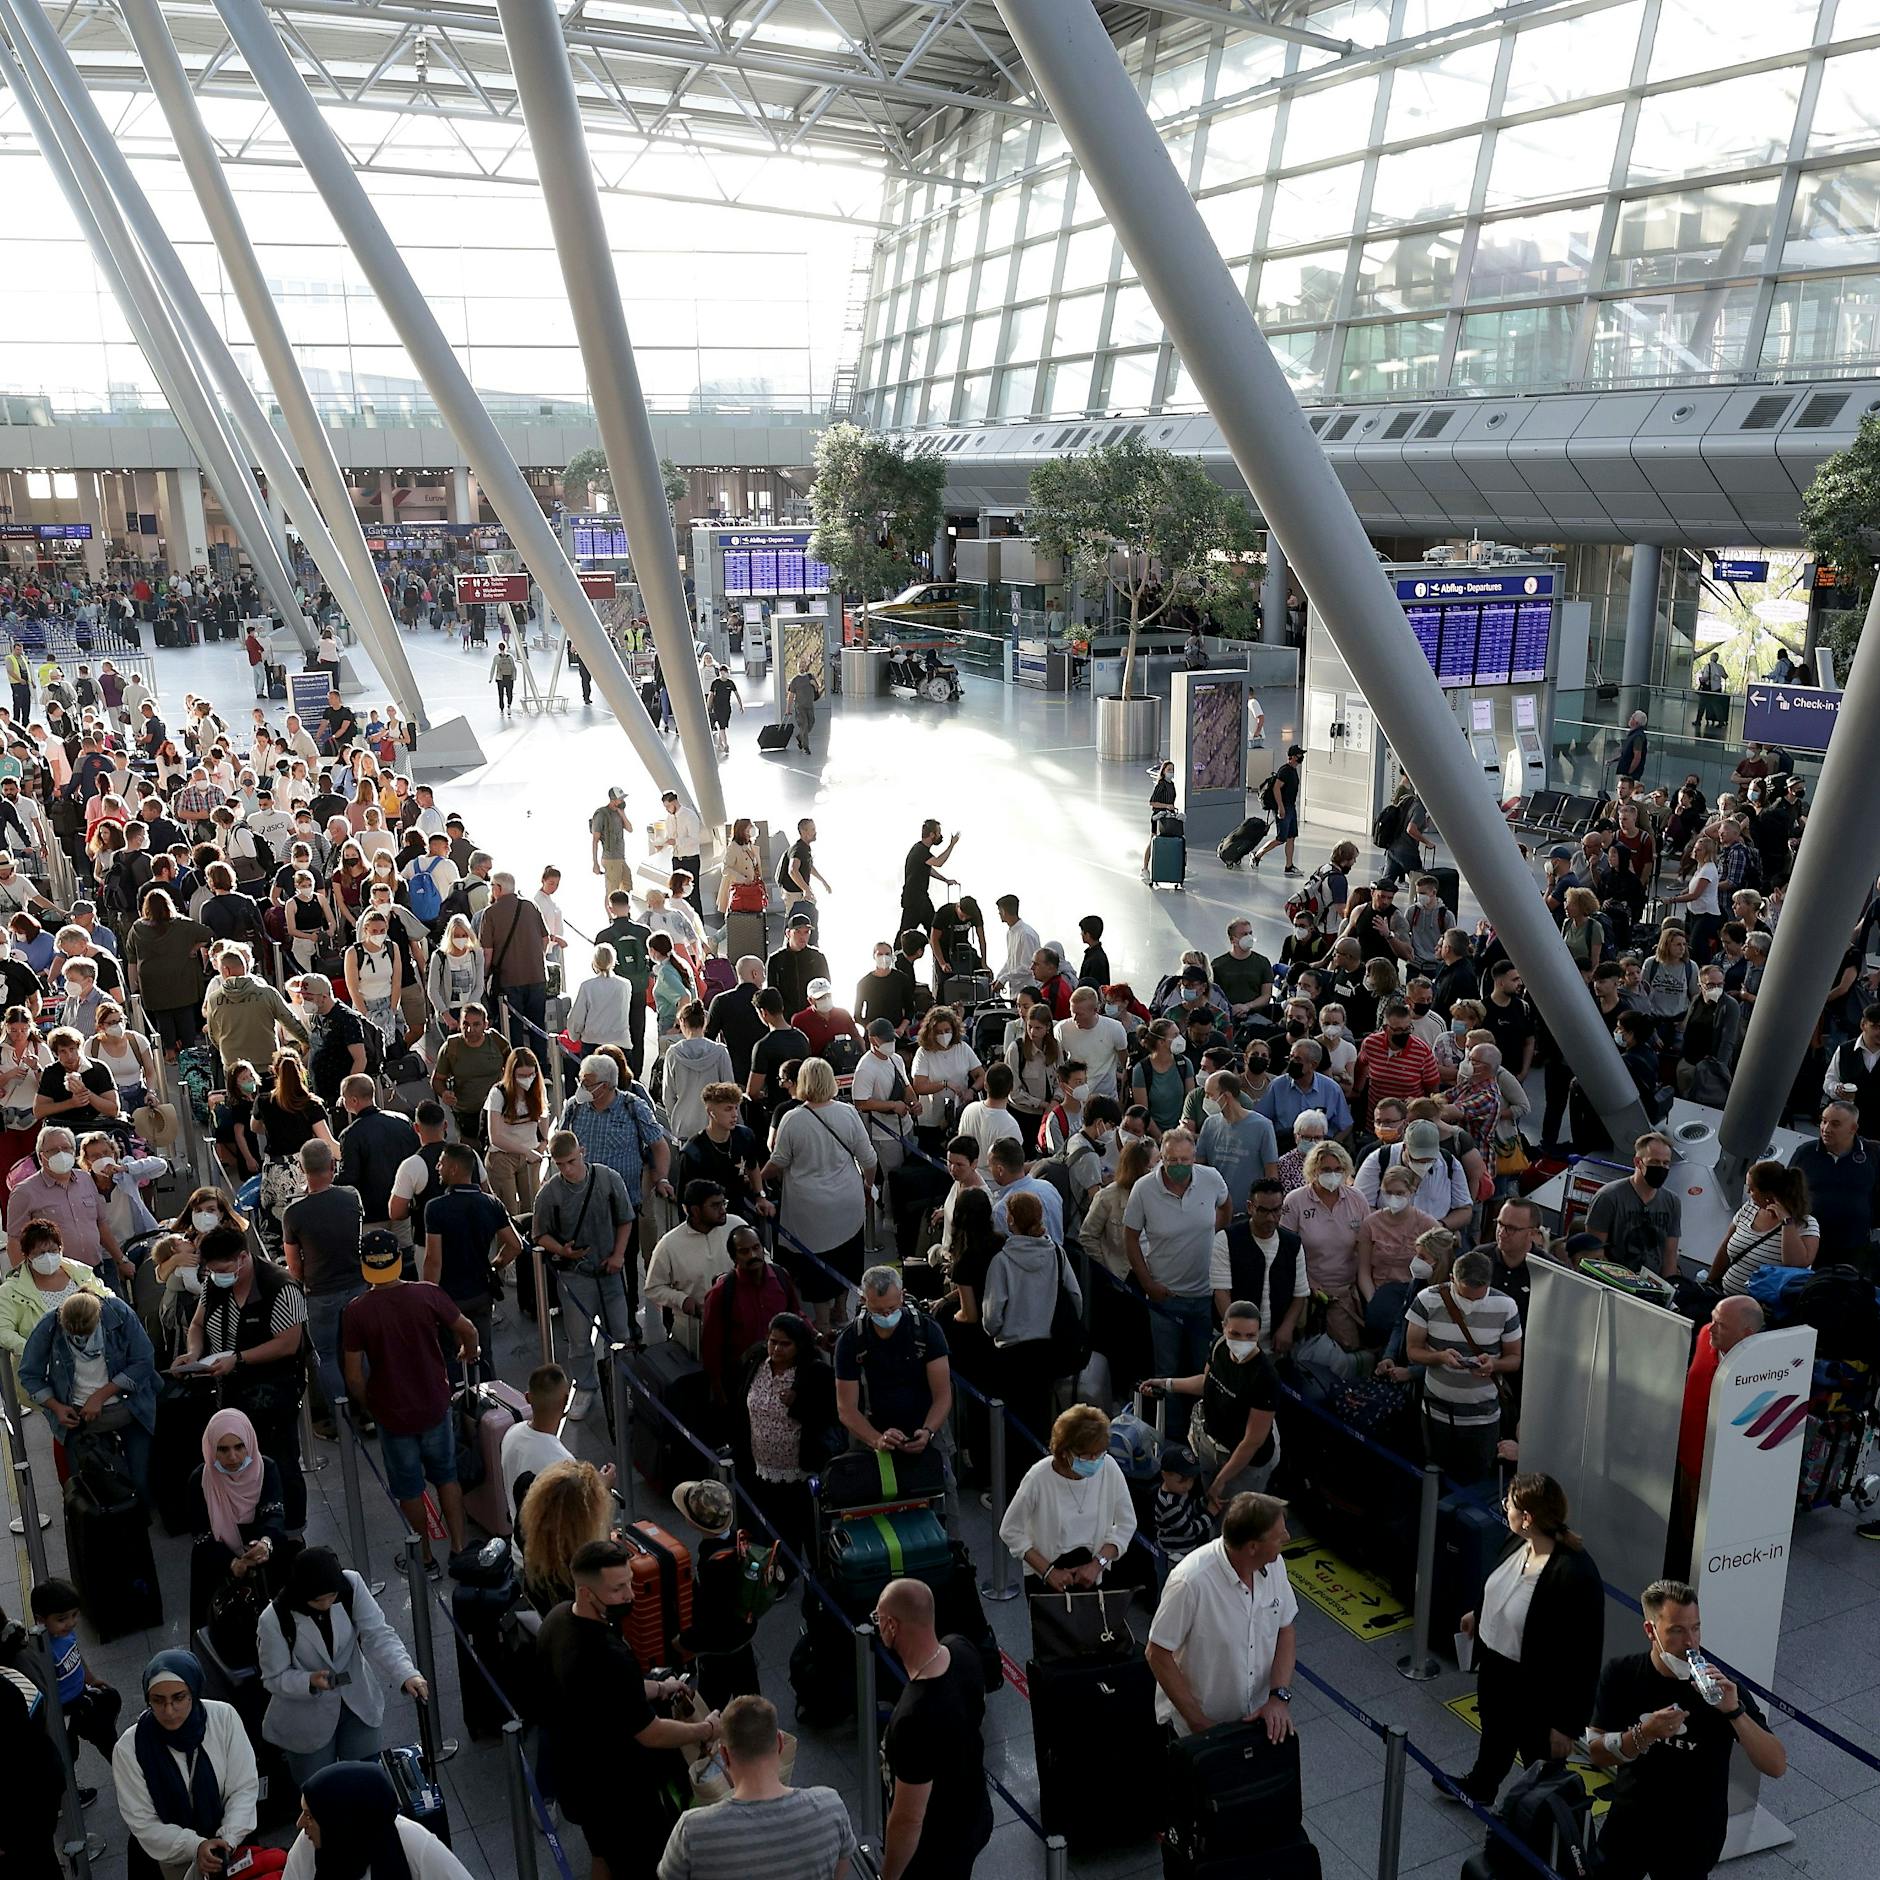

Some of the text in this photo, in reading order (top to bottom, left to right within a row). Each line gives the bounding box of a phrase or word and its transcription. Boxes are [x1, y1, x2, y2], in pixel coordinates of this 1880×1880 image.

[1440, 582, 1502, 594] Abflug Departures
[1793, 697, 1834, 711] Check-in
[1303, 1208, 1316, 1219] 97
[1735, 1368, 1790, 1386] Eurowings
[1708, 1543, 1783, 1573] Check-in
